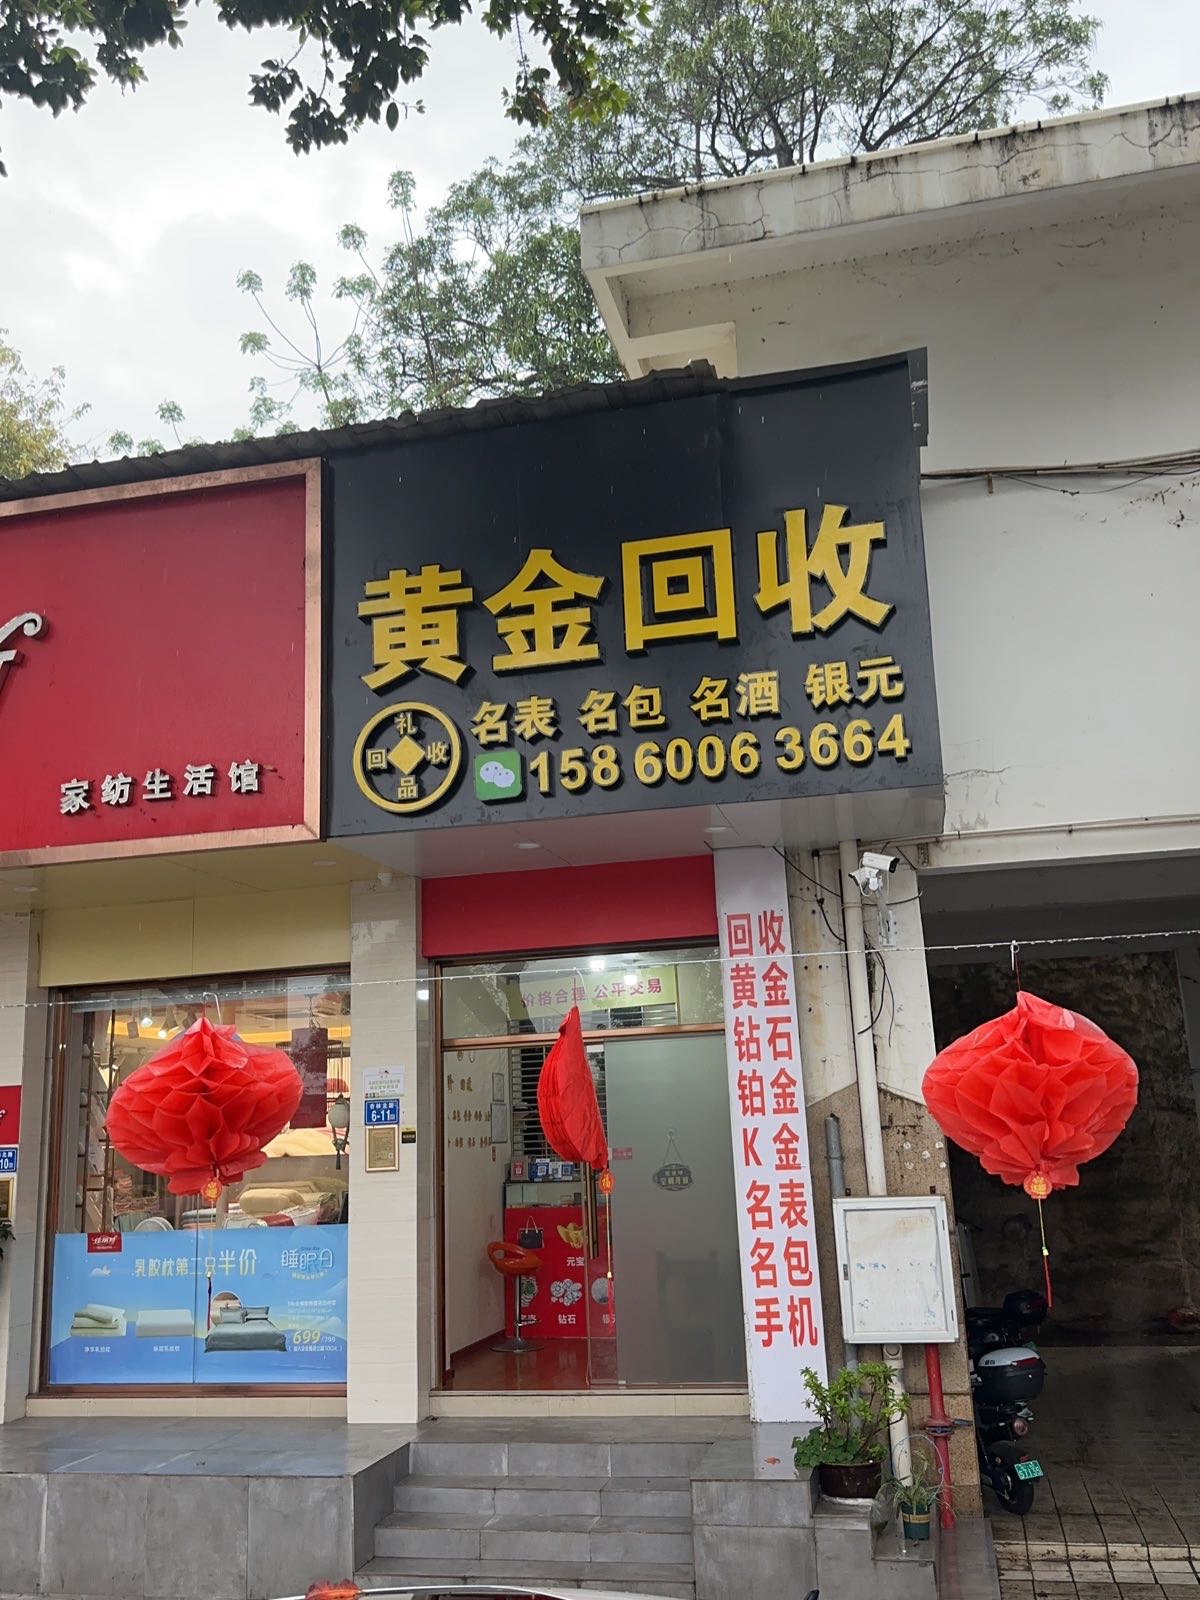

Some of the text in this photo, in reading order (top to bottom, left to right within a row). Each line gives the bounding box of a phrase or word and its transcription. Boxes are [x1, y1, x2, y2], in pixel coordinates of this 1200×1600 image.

[357, 503, 895, 690] 黄金回收
[471, 656, 906, 744] 名表 名包 名酒 银元
[529, 713, 911, 793] 158 6006 3664
[60, 759, 260, 815] 家纺生活馆
[727, 910, 785, 957] 回收
[594, 978, 662, 999] 公平交易
[730, 961, 790, 1009] 黄金
[734, 1016, 793, 1062] 钻石
[737, 1068, 799, 1117] 铂金
[742, 1123, 801, 1171] K金
[746, 1179, 808, 1230] 名表
[750, 1237, 813, 1288] 名包
[558, 1314, 576, 1324] 钻石
[755, 1295, 818, 1347] 手机
